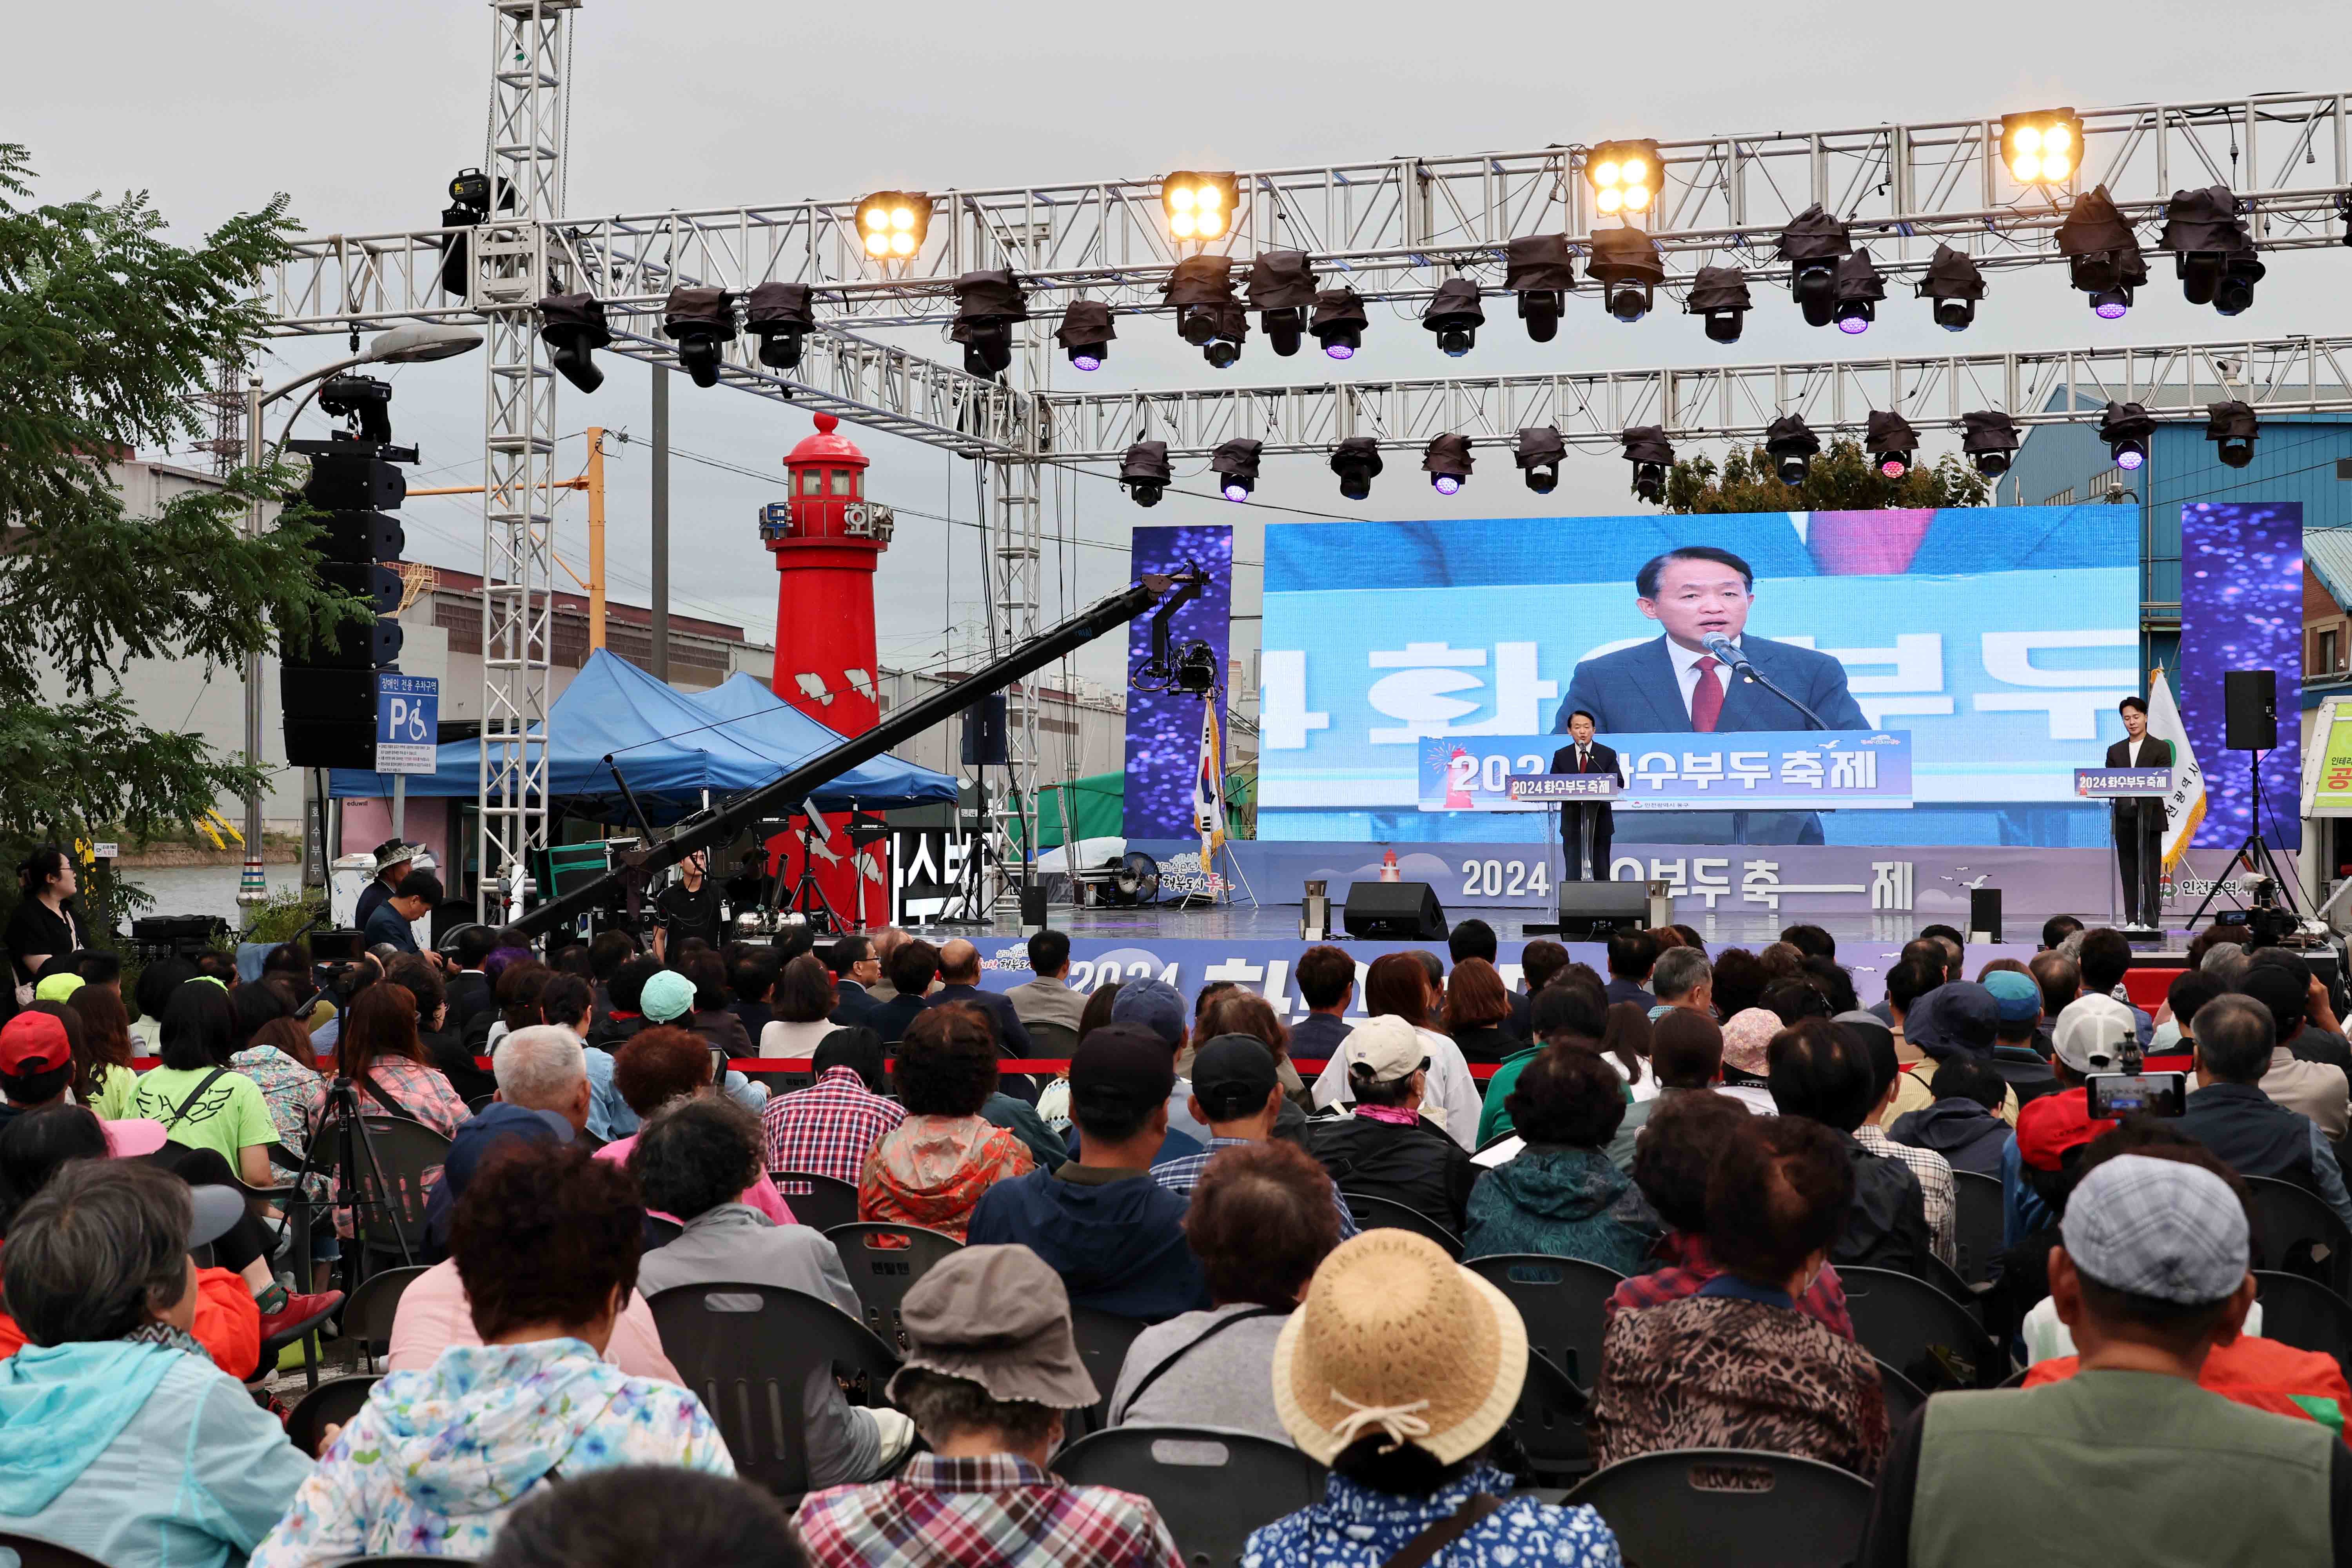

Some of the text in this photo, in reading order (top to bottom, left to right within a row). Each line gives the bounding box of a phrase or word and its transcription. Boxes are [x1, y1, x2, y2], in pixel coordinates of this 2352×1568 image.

[381, 677, 437, 693] 장애인 전용 주차구역
[389, 698, 407, 740] P
[1780, 750, 1877, 789] 축제
[1512, 780, 1610, 795] 2024 화수부두 축제
[2079, 776, 2167, 788] 2024 화수부두 축제
[1171, 863, 1187, 873] 싶은
[1163, 875, 1204, 893] 행복도시
[1462, 859, 1550, 897] 2024
[1742, 859, 1913, 911] 축제
[871, 1261, 909, 1275] 렌탈맨
